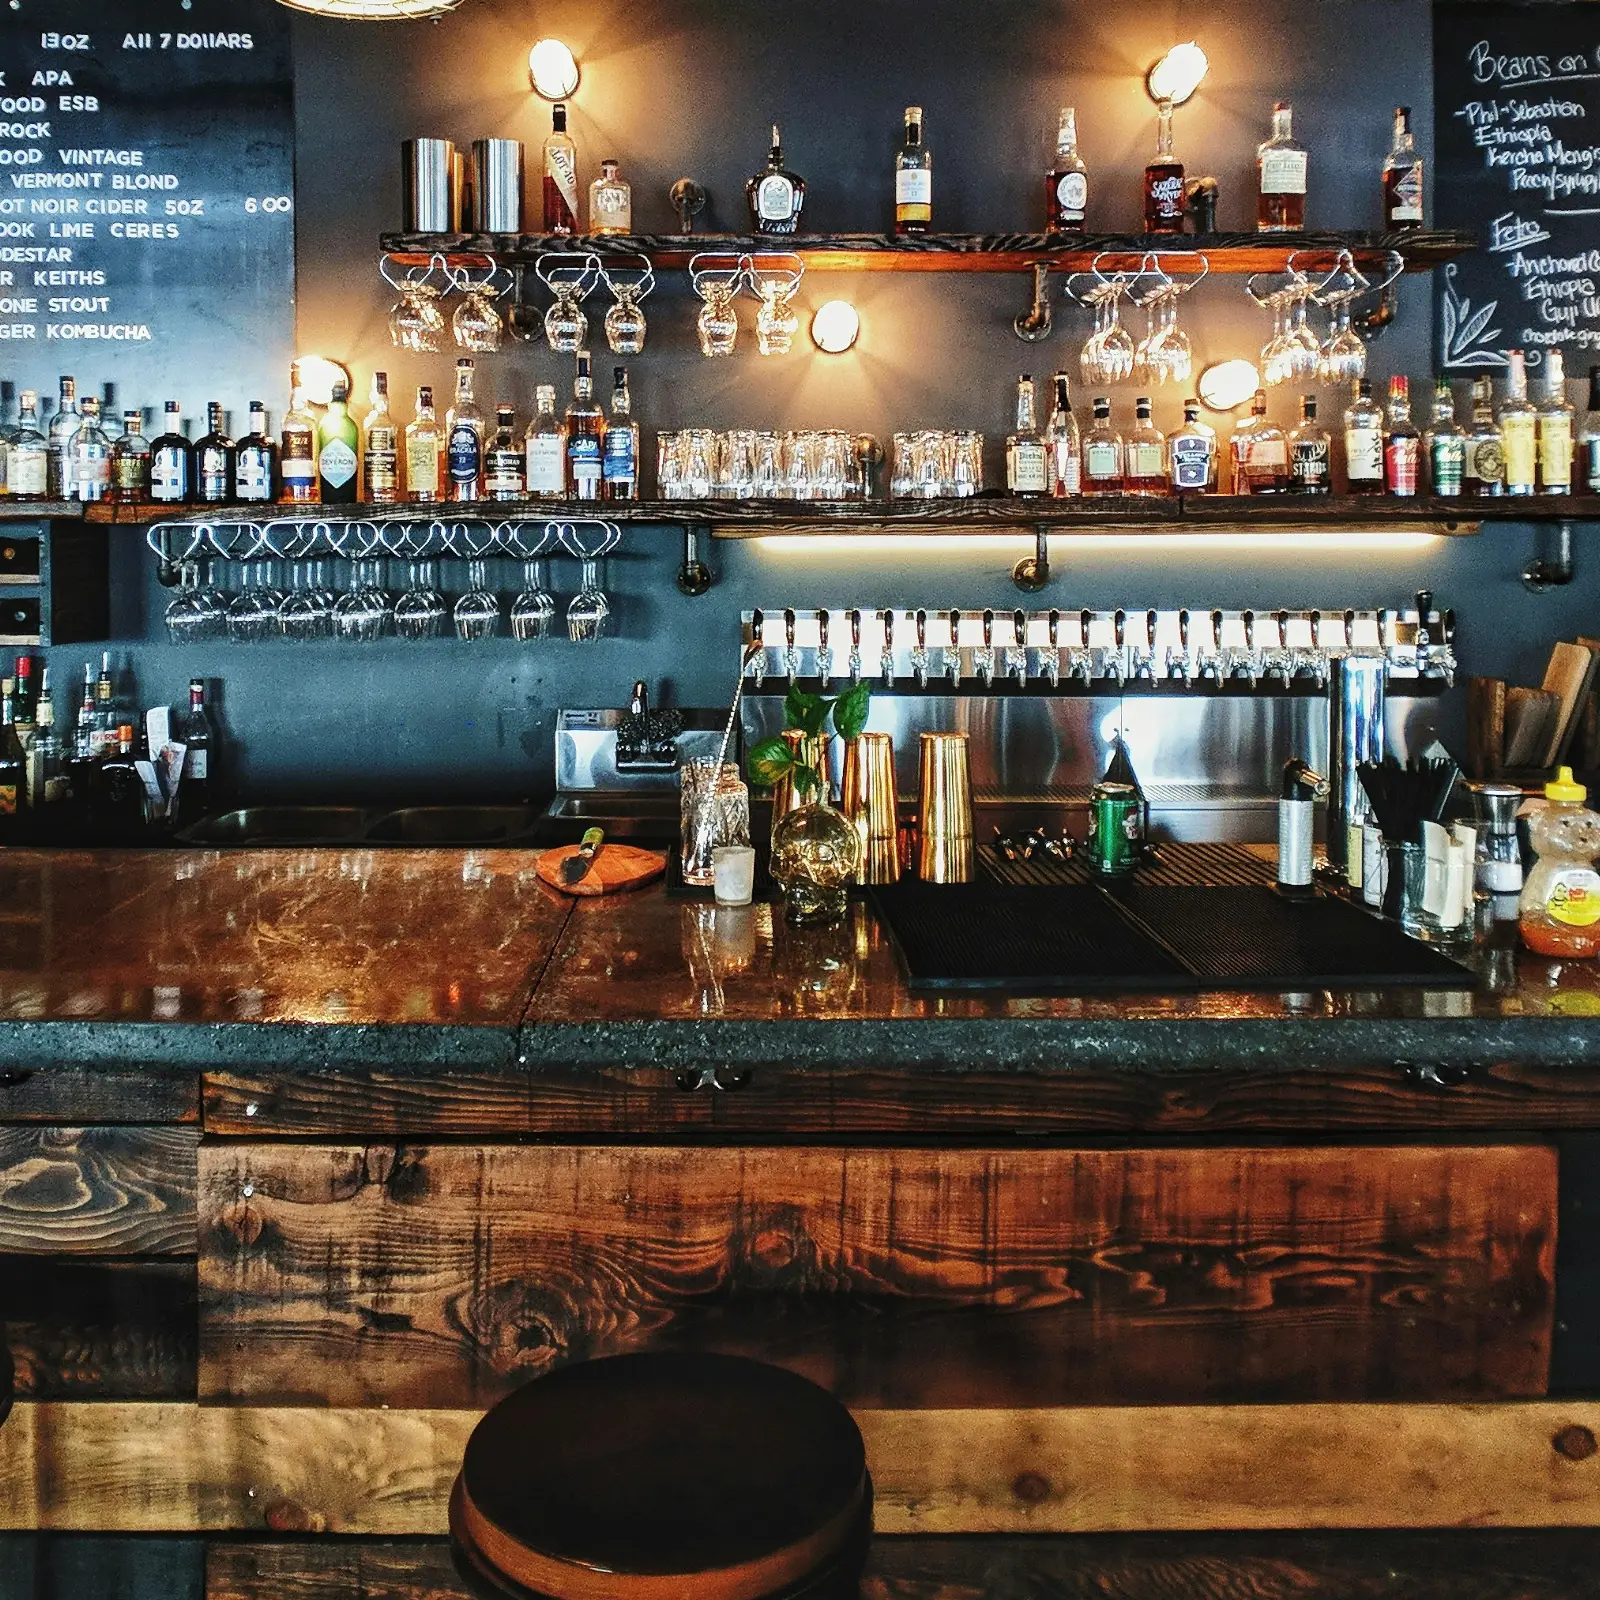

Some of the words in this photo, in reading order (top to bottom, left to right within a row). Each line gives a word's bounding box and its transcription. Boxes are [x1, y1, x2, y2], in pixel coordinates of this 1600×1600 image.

[160, 33, 172, 48] 7
[1469, 40, 1551, 83] Beans
[1558, 54, 1588, 71] on
[31, 71, 74, 86] APA
[0, 96, 46, 113] OOD
[59, 96, 99, 111] ESB
[0, 123, 51, 139] ROCK
[1475, 123, 1553, 148] Ethiopia
[59, 149, 144, 166] VINTAGE
[11, 173, 103, 189] VERMONT
[112, 174, 179, 190] BLOND
[31, 199, 79, 214] NOIR
[85, 199, 148, 214] CIDER
[244, 197, 257, 213] 6
[50, 223, 94, 238] LIME
[110, 223, 180, 239] CERES
[0, 270, 13, 285] R
[34, 270, 106, 286] KEITHS
[1523, 275, 1595, 301] Ethiopia
[0, 298, 37, 313] ONE
[49, 297, 110, 313] STOUT
[0, 324, 36, 339] GER
[47, 324, 152, 341] KOMBUCHA
